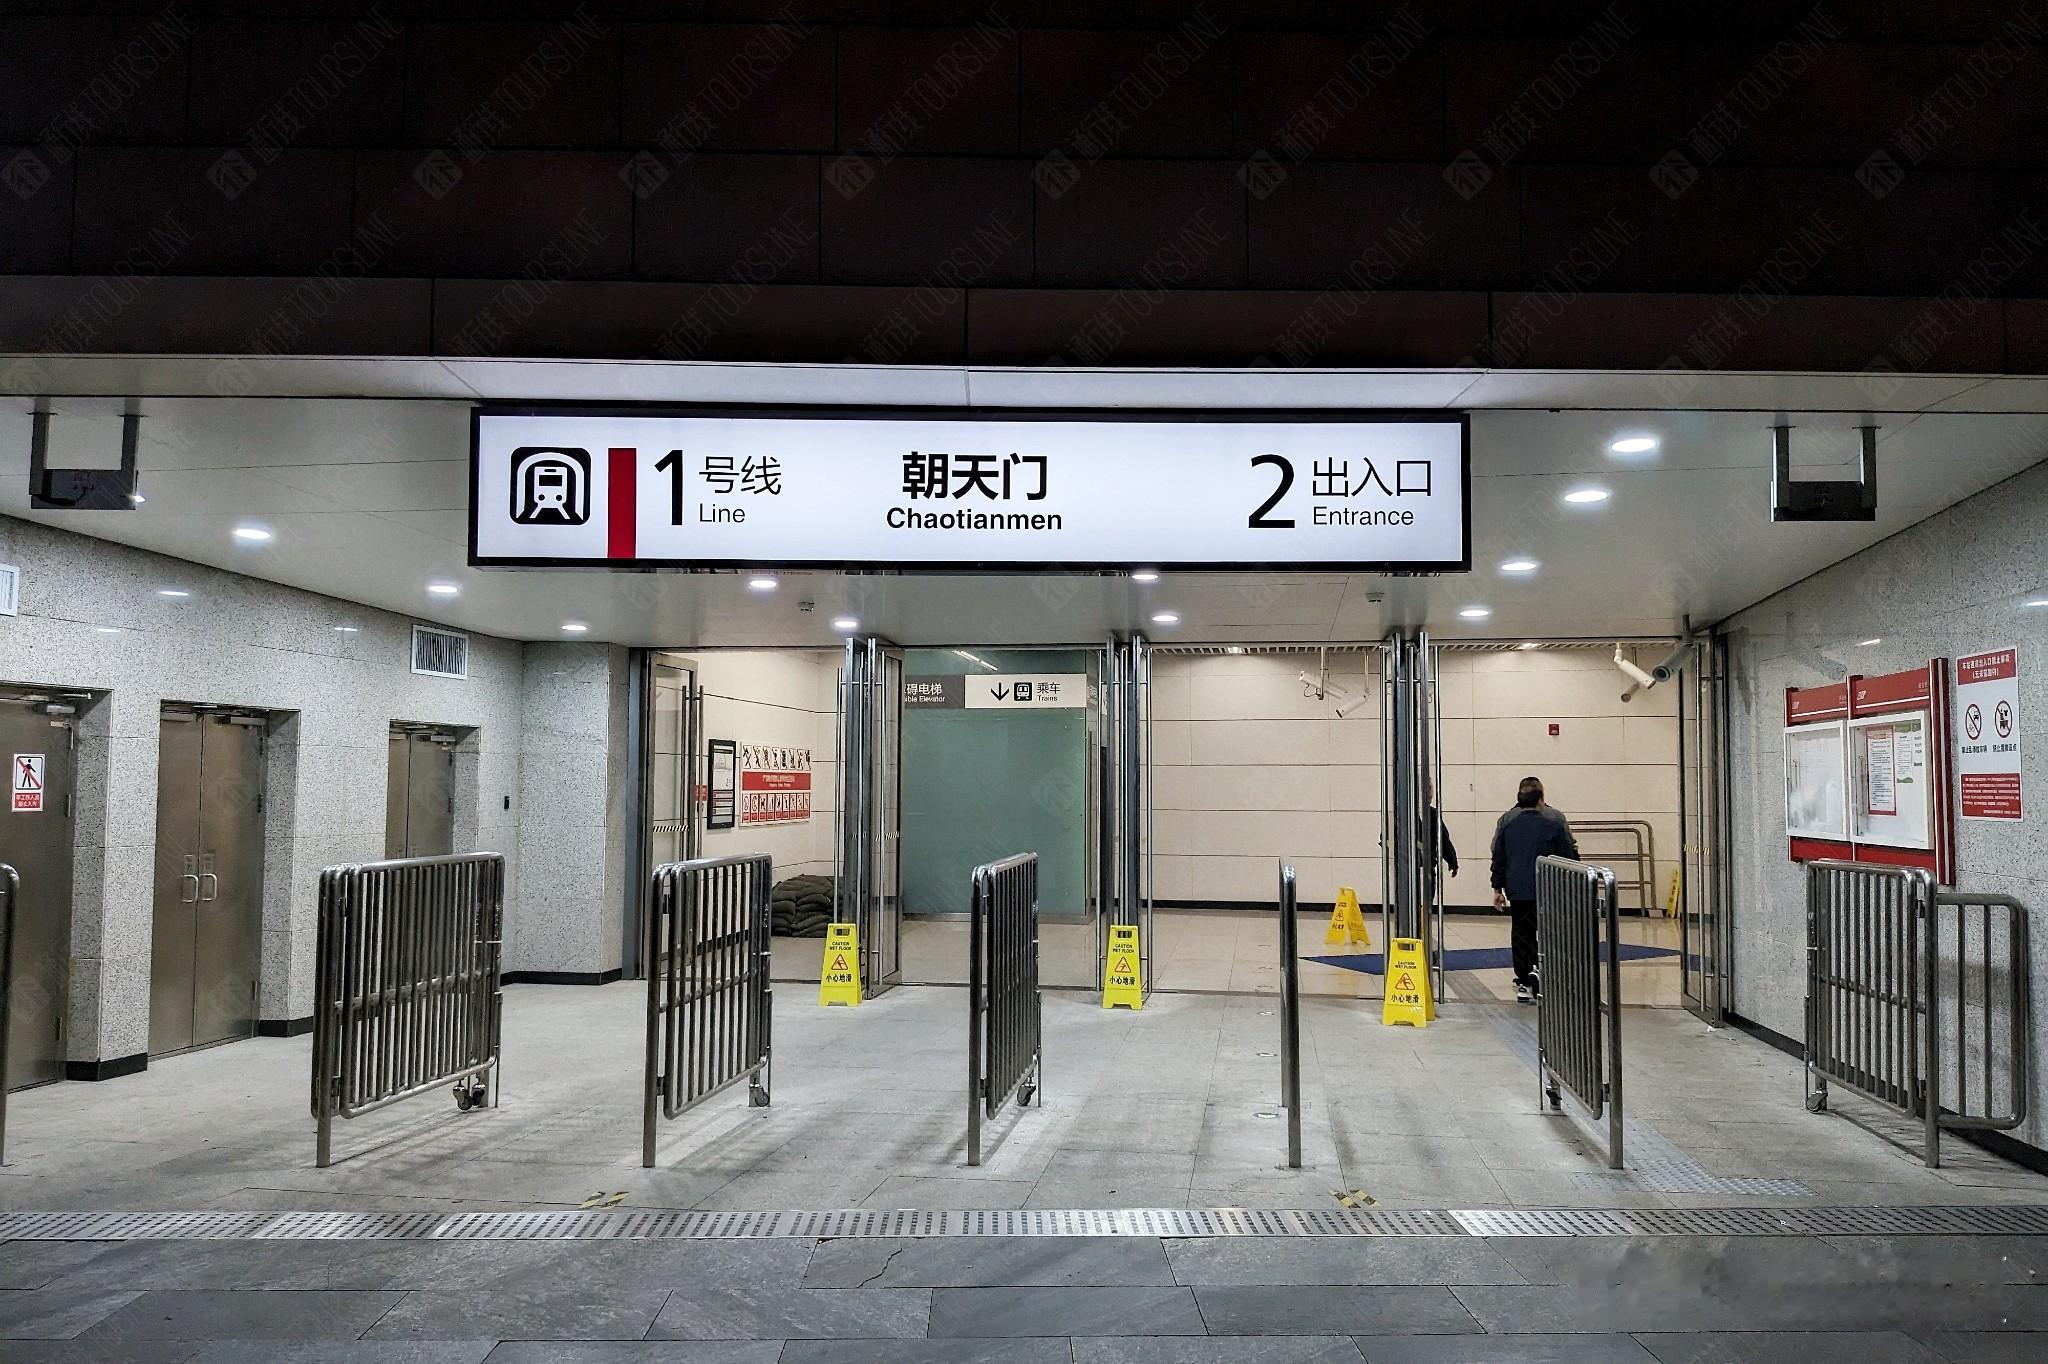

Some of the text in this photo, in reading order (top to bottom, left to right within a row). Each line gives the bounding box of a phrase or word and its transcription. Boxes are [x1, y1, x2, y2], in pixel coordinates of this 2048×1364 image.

[902, 450, 1048, 501] 朝天门
[655, 450, 782, 526] 1 号线
[1249, 453, 1433, 529] 2 出入口
[700, 503, 745, 524] Line
[887, 506, 1062, 531] Chaotianmen
[1314, 506, 1414, 526] Entrance
[1037, 682, 1060, 694] 乘车
[825, 973, 852, 983] 小心地滑
[1109, 976, 1136, 986] 小心地滑
[1391, 994, 1419, 1003] 小心地滑
